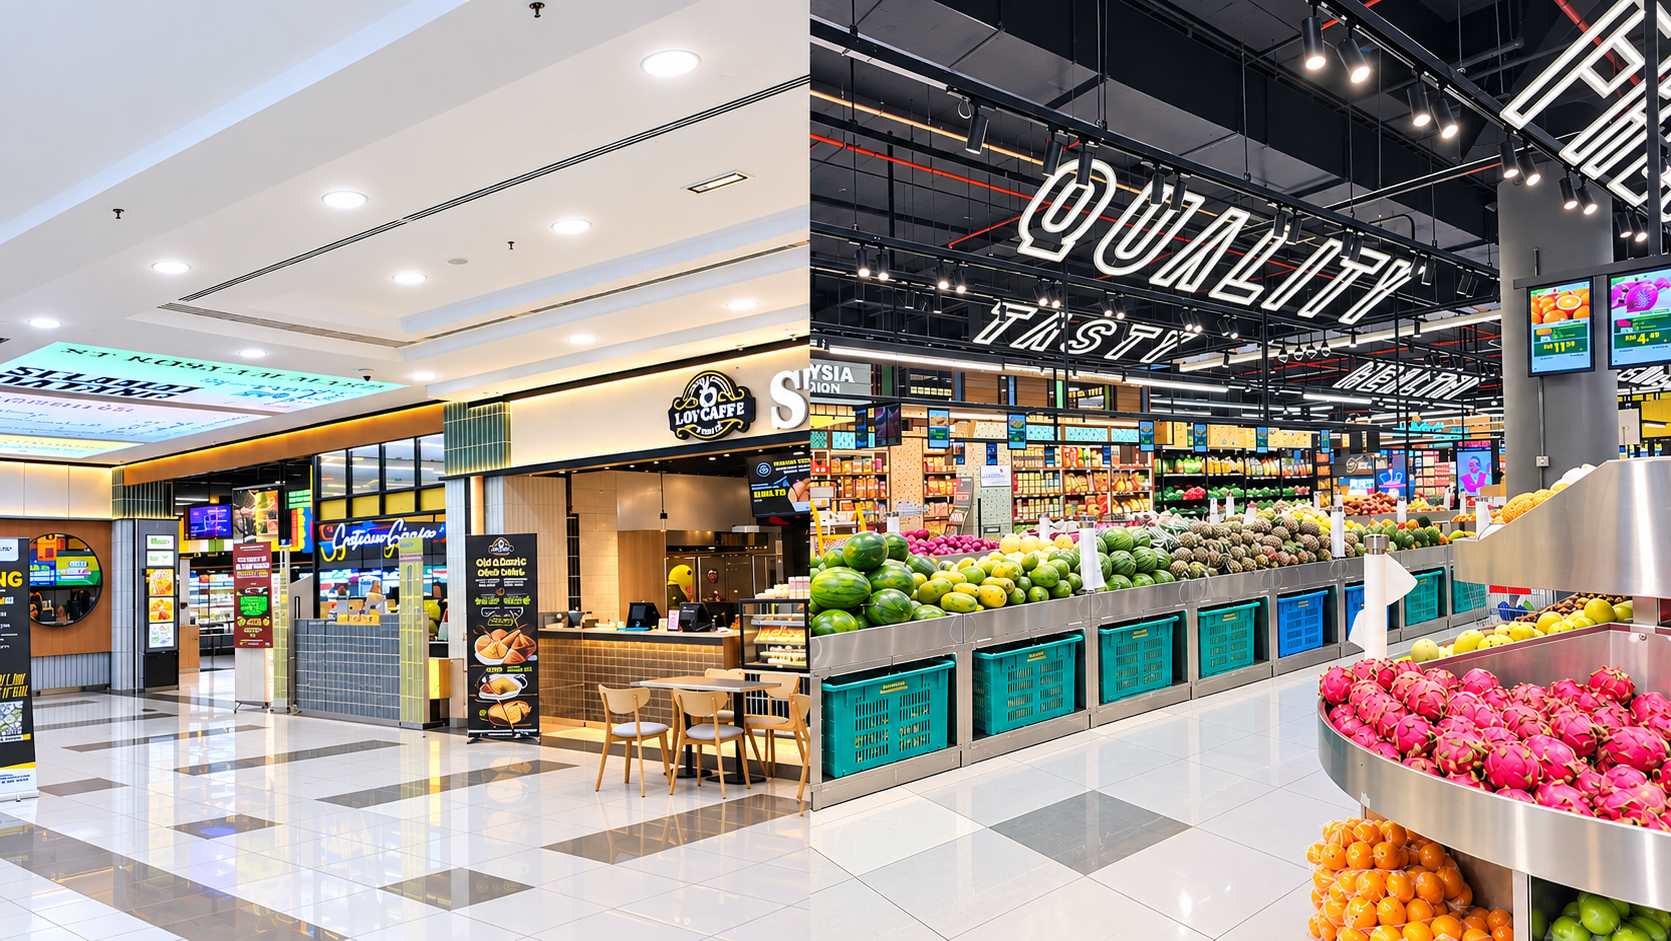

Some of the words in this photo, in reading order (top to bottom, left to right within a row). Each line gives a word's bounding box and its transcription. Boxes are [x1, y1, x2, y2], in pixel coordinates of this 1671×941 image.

[1017, 159, 1428, 325] QUALITY
[972, 301, 1199, 363] TASTY
[770, 368, 810, 430] S
[809, 364, 856, 382] YSIA
